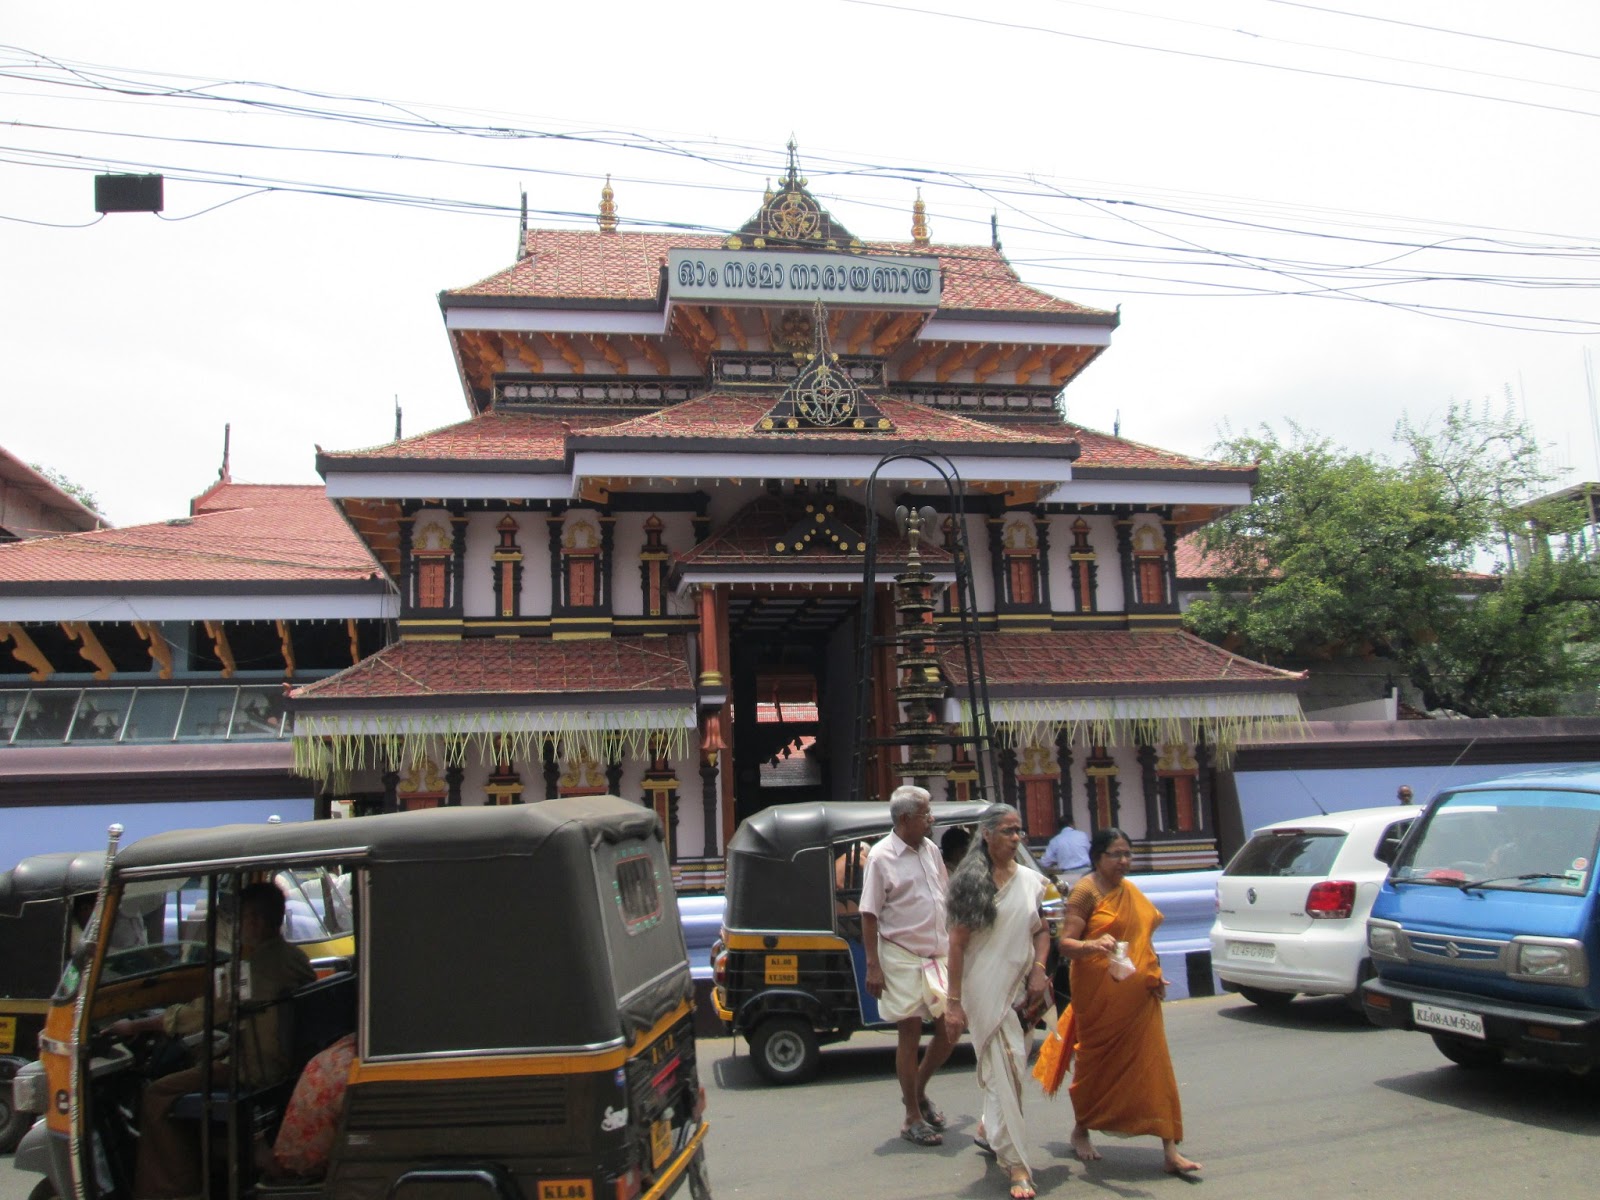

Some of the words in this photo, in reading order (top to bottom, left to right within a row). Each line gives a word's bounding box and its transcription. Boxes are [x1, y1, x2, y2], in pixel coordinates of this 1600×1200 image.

[678, 260, 719, 288] ഓം
[724, 261, 785, 290] നമോ
[790, 264, 933, 294] നാരായണായ
